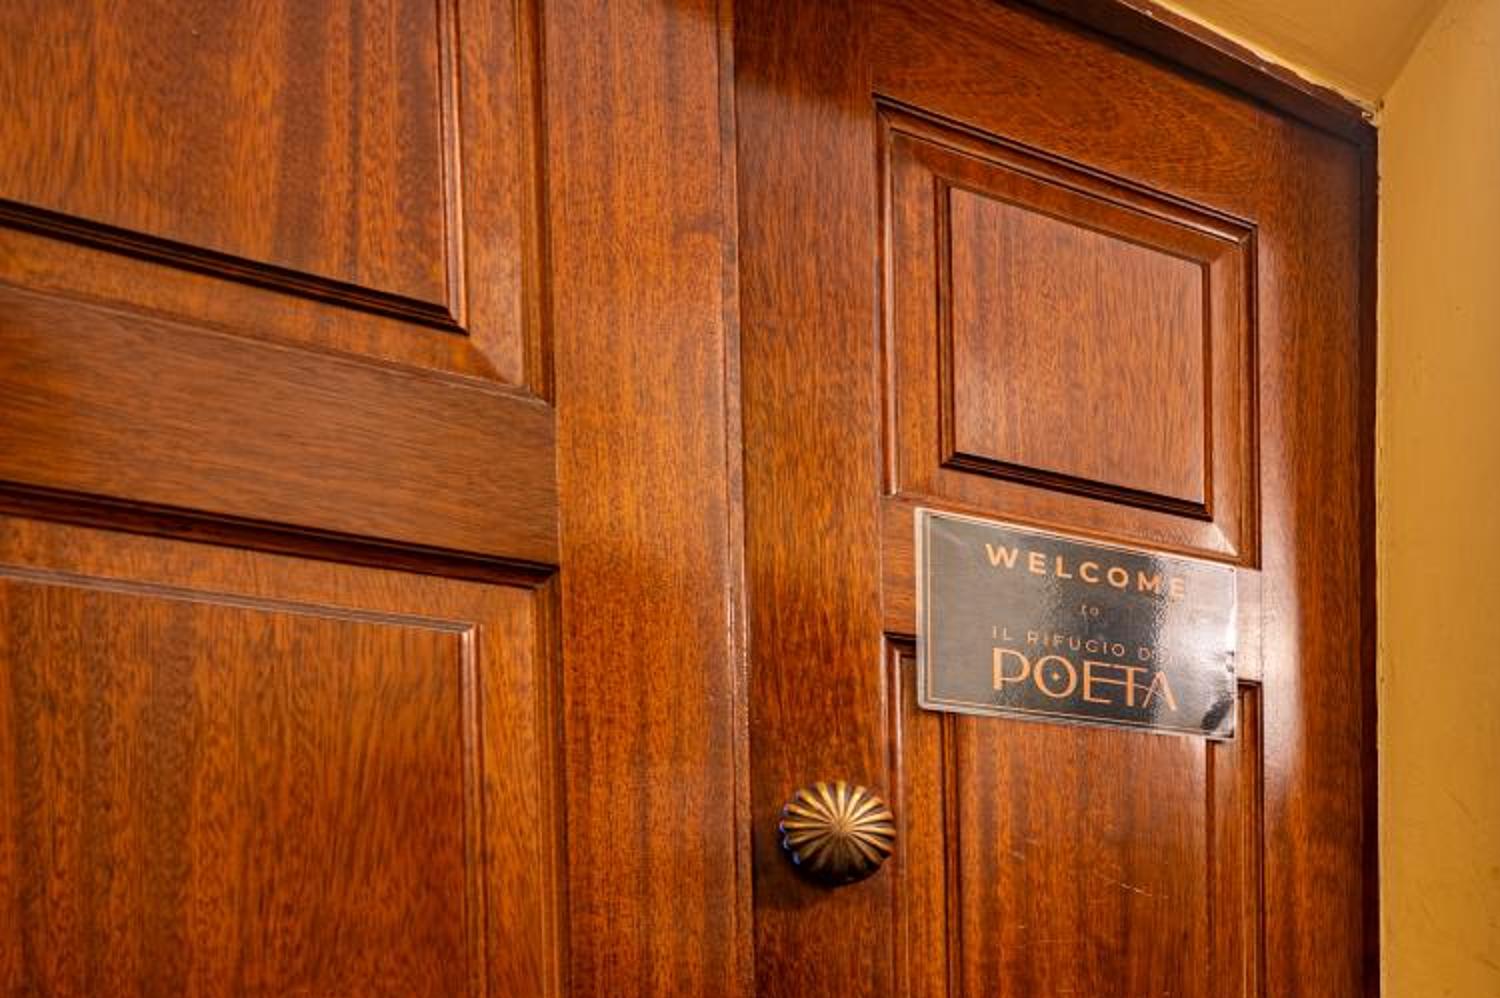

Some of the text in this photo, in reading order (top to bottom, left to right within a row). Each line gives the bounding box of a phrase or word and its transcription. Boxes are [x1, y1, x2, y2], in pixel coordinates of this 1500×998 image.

[985, 544, 1185, 598] WELCOME
[993, 626, 1126, 657] IL RIFUGIO
[992, 646, 1177, 711] POETA
